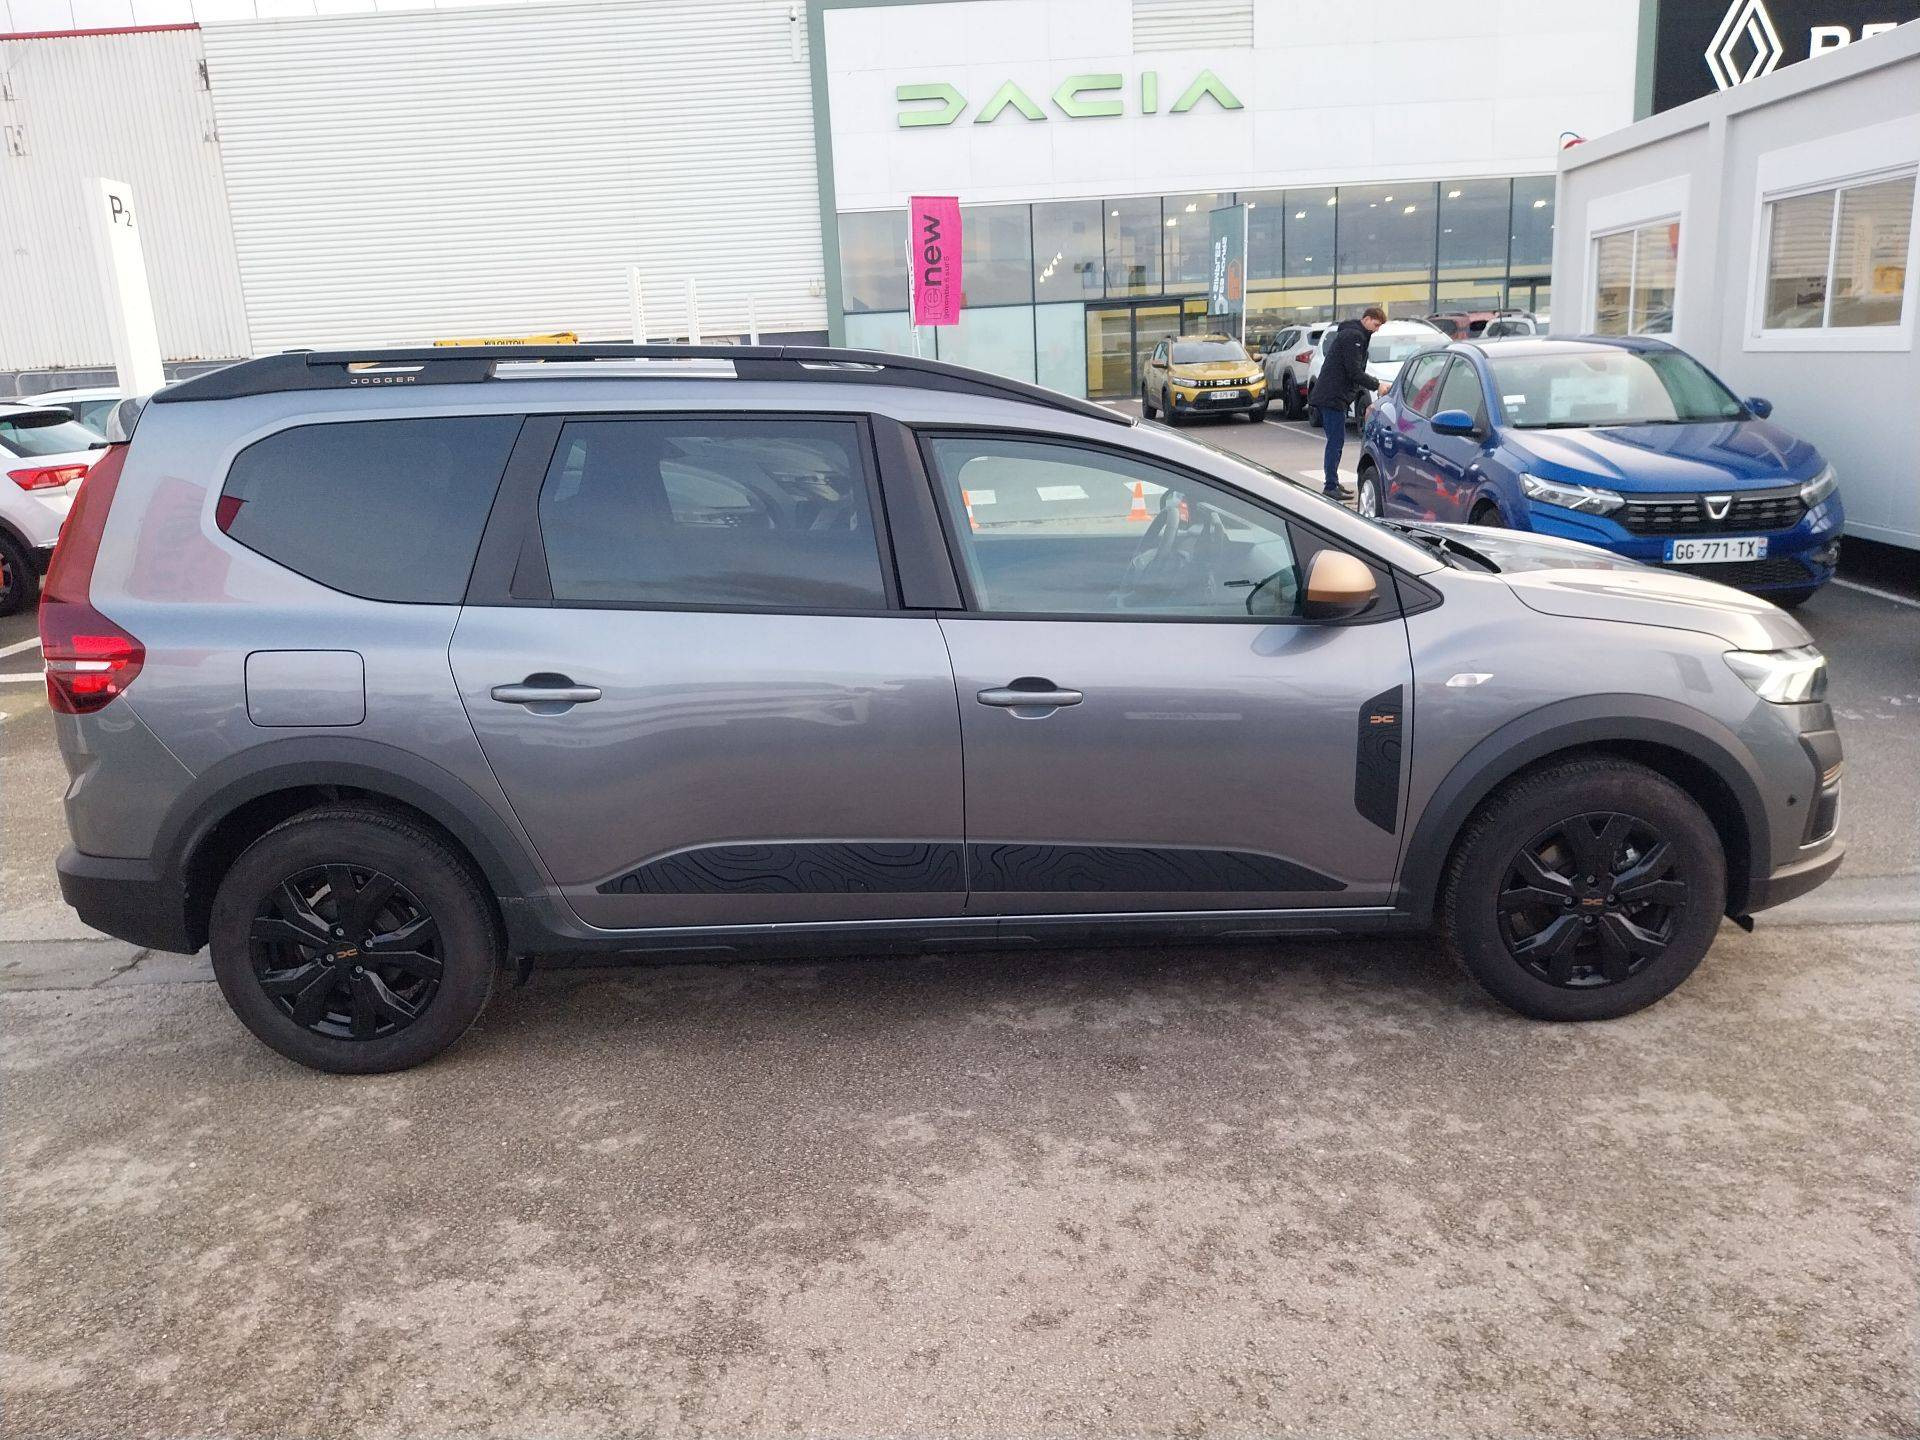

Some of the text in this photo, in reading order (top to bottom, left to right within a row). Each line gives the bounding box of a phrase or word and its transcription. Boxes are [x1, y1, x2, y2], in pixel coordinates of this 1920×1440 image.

[896, 68, 1245, 128] DACIA
[923, 214, 942, 320] renew
[350, 376, 417, 386] JOGGER
[1675, 541, 1756, 560] GG-771-TX
